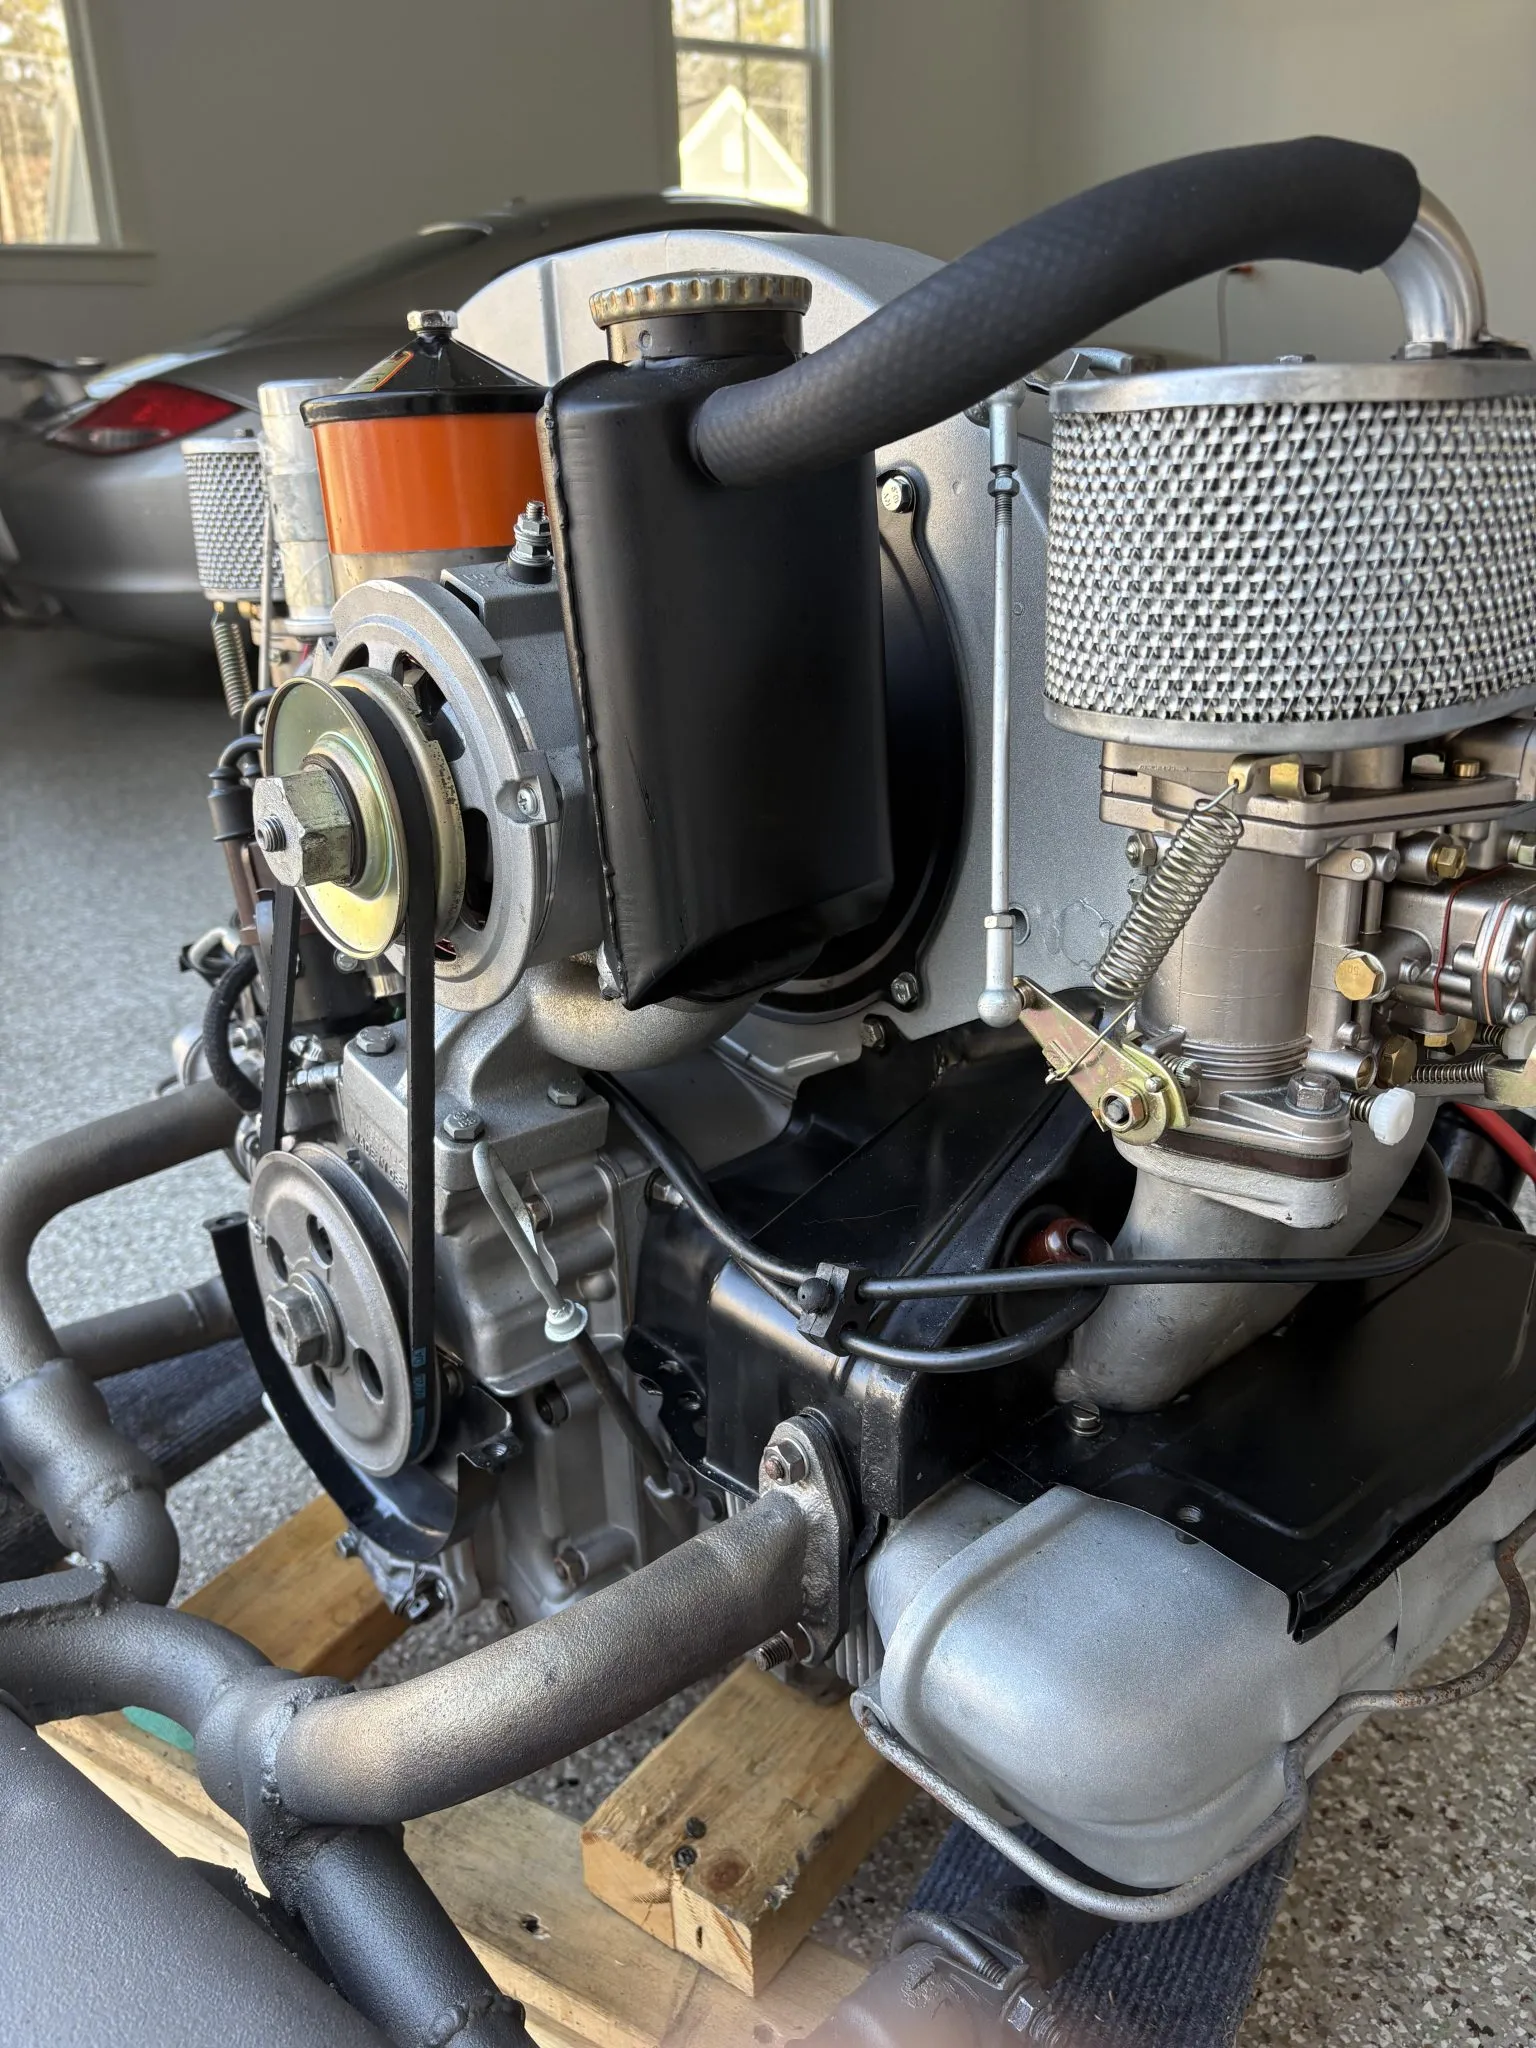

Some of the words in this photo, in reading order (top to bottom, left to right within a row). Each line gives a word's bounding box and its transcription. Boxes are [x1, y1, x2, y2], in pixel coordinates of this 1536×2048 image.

[353, 1127, 378, 1162] MADE
[379, 1155, 388, 1173] IN
[390, 1167, 408, 1194] GER
